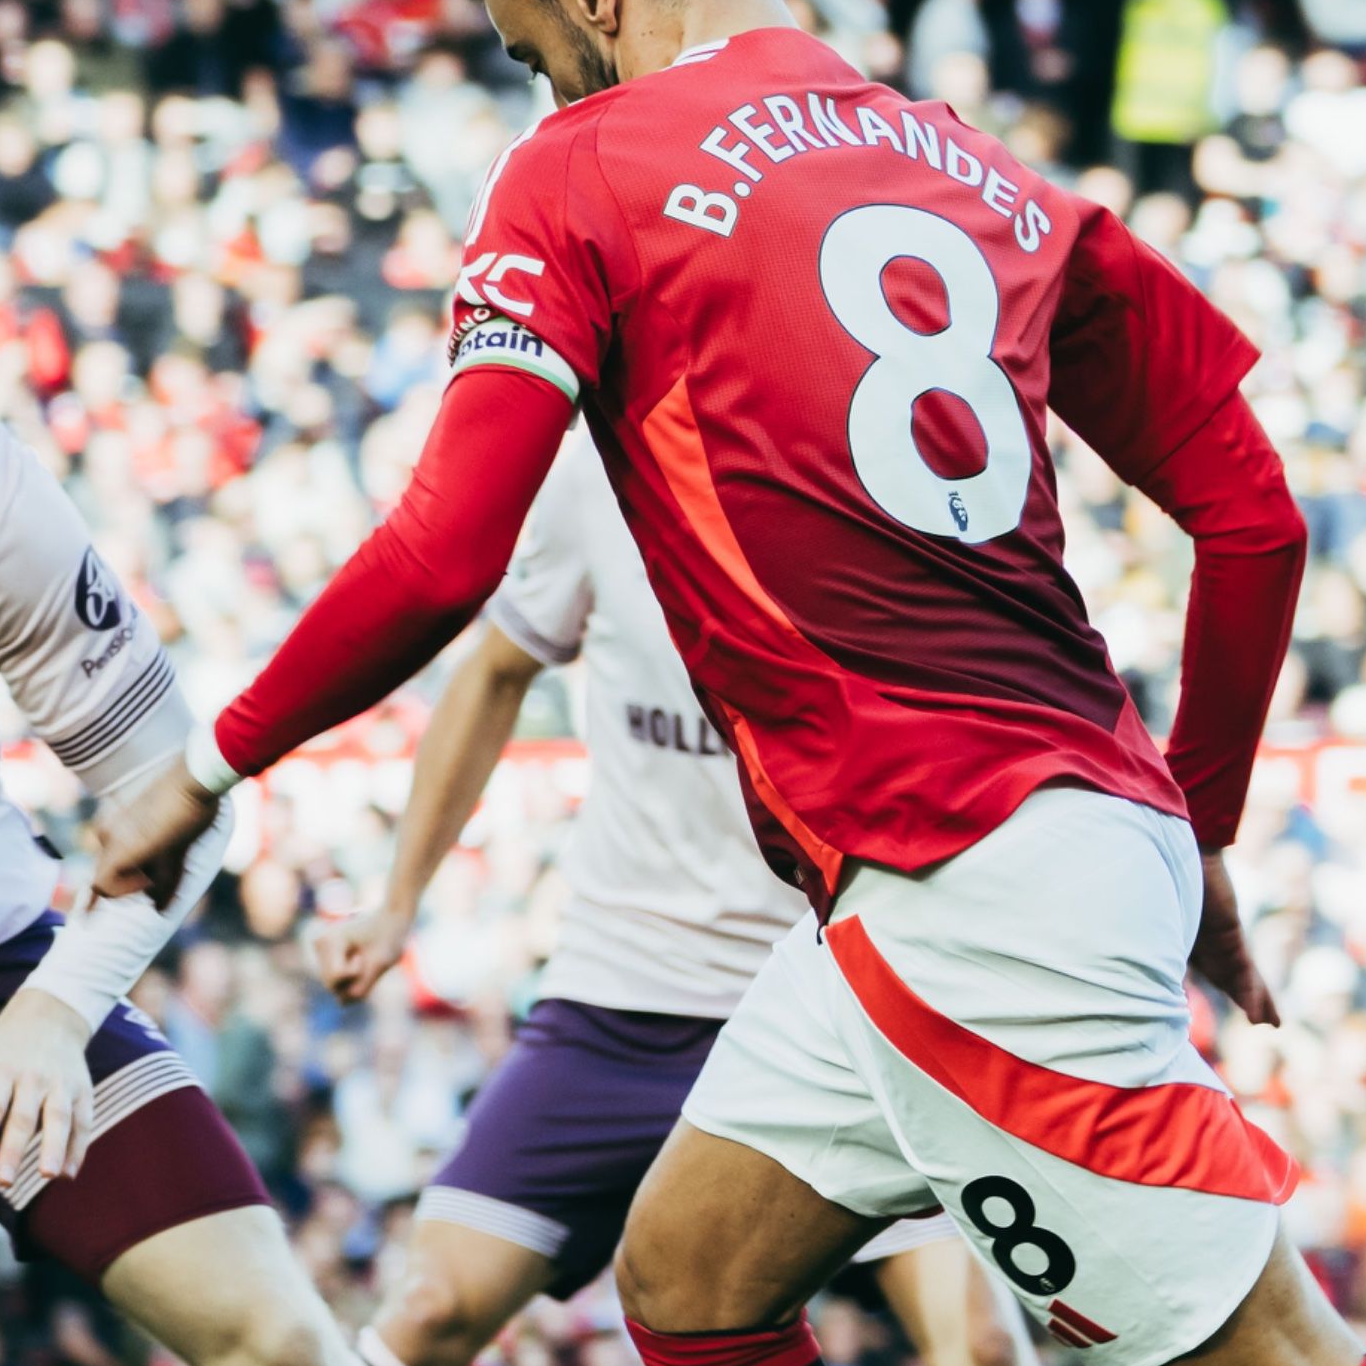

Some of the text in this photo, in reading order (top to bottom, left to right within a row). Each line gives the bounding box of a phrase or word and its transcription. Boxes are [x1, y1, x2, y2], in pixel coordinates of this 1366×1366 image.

[663, 92, 1052, 253] B.FERNANDES
[817, 203, 1034, 546] 8
[960, 1175, 1077, 1297] 8
